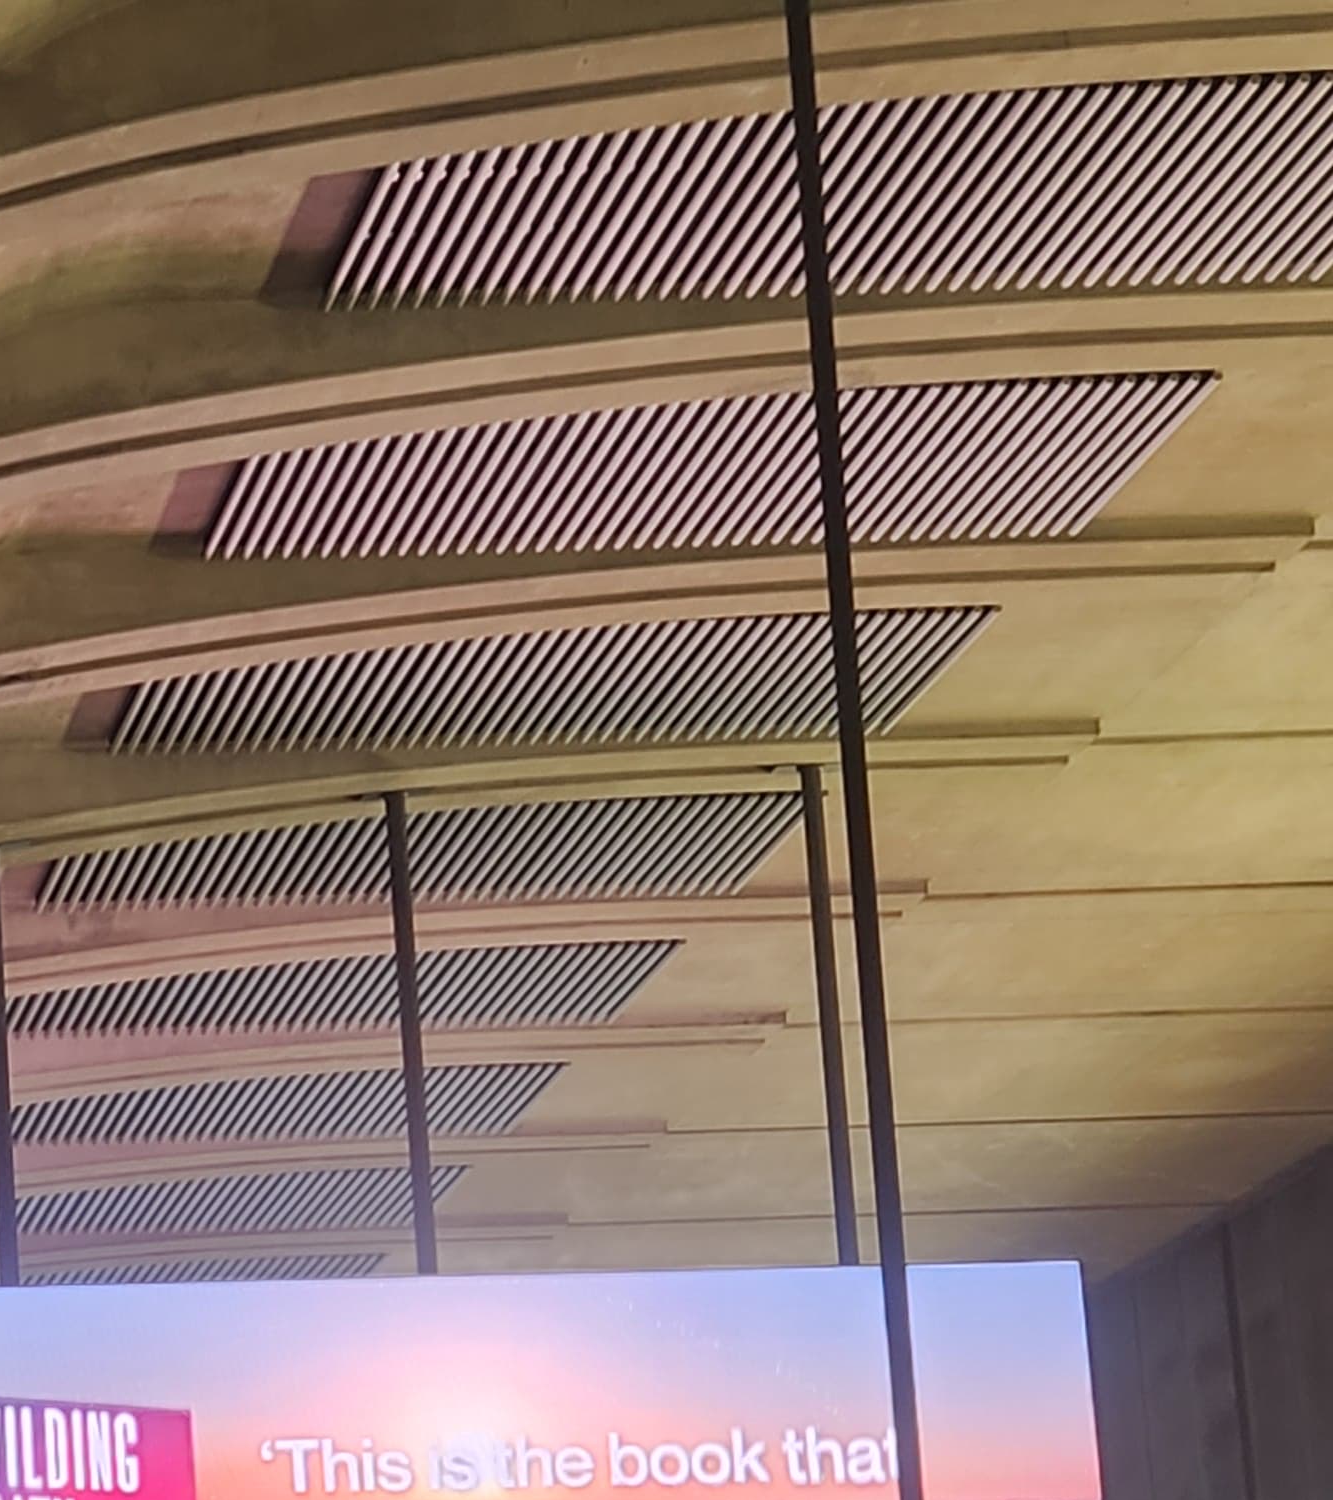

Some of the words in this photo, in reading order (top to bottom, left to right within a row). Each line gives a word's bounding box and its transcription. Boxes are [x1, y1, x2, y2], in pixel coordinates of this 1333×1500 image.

[259, 1437, 413, 1495] ‘This
[430, 1440, 478, 1491] is
[496, 1435, 595, 1489] the
[609, 1430, 770, 1487] book
